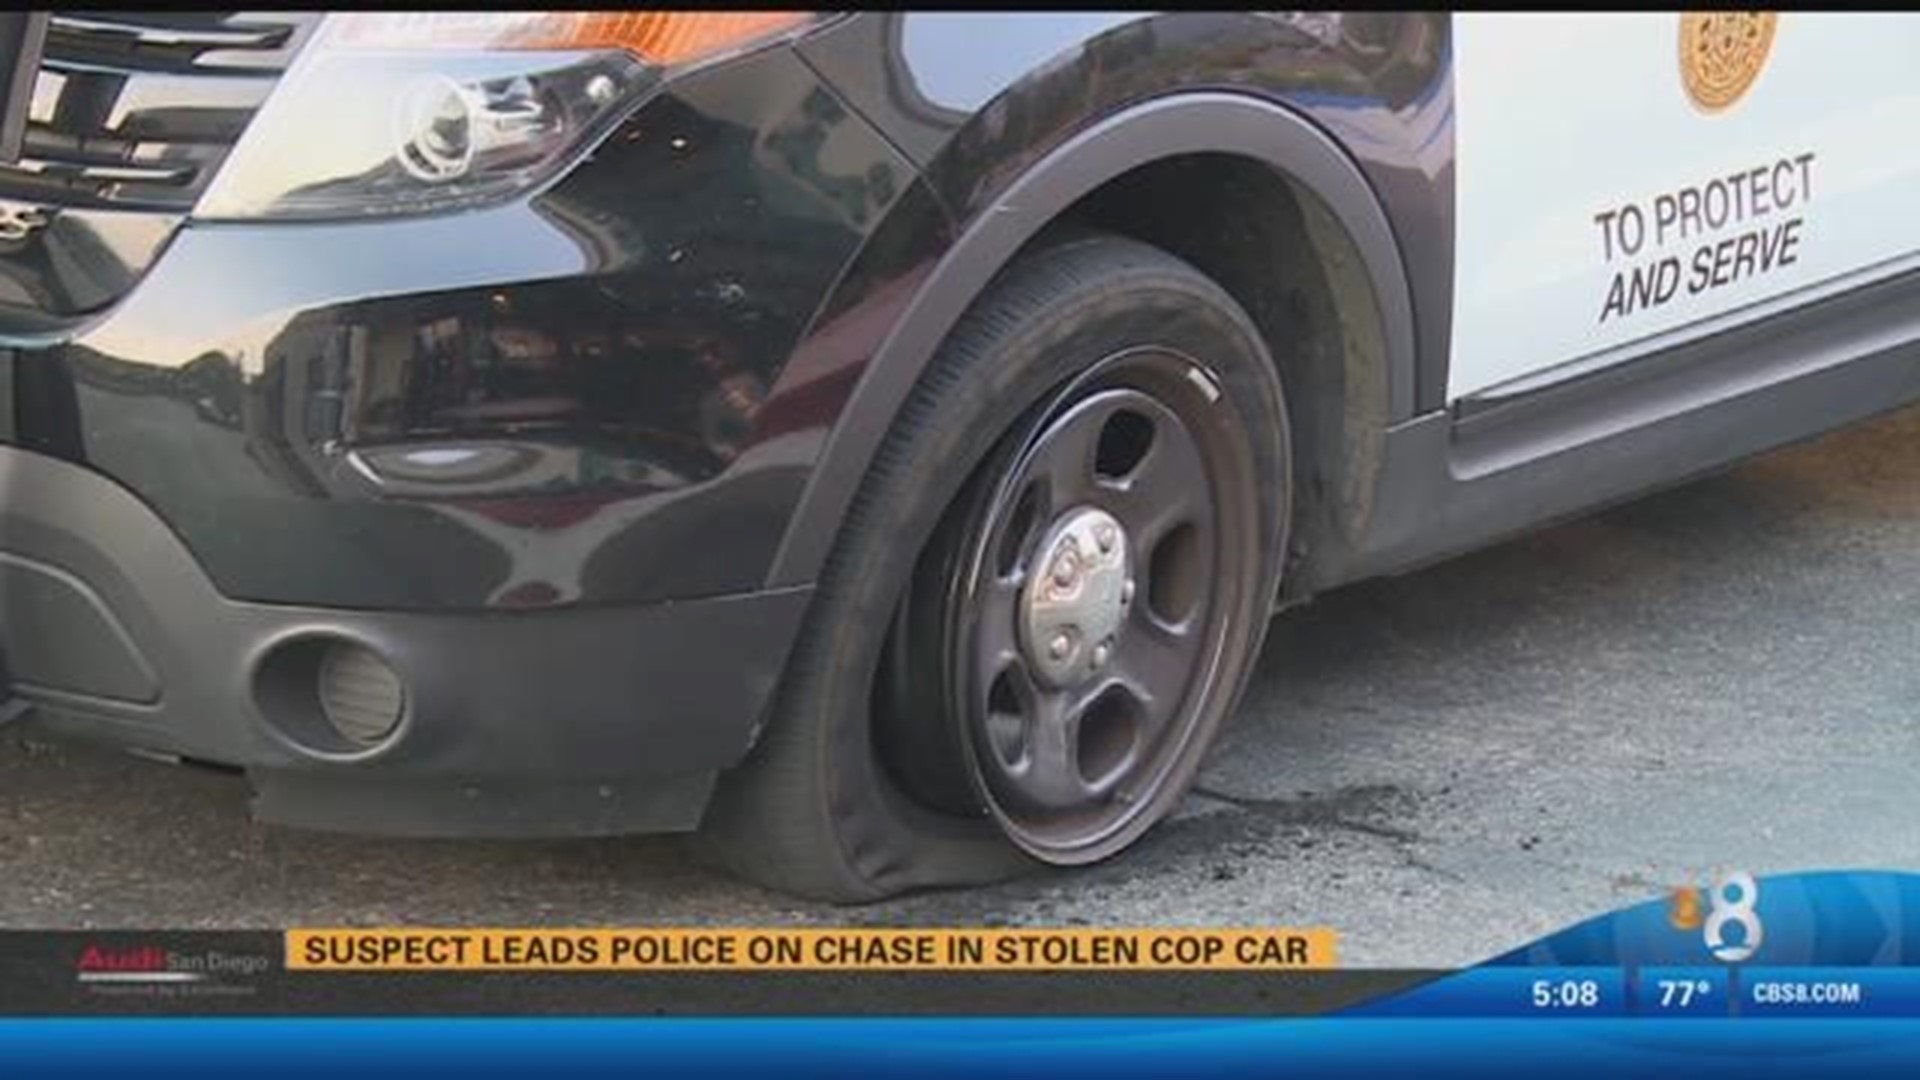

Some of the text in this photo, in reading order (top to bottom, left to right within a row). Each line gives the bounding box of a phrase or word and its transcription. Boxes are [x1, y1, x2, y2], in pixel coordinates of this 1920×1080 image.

[1594, 153, 1815, 261] TO PROTECT
[1599, 218, 1804, 324] AND SERVE
